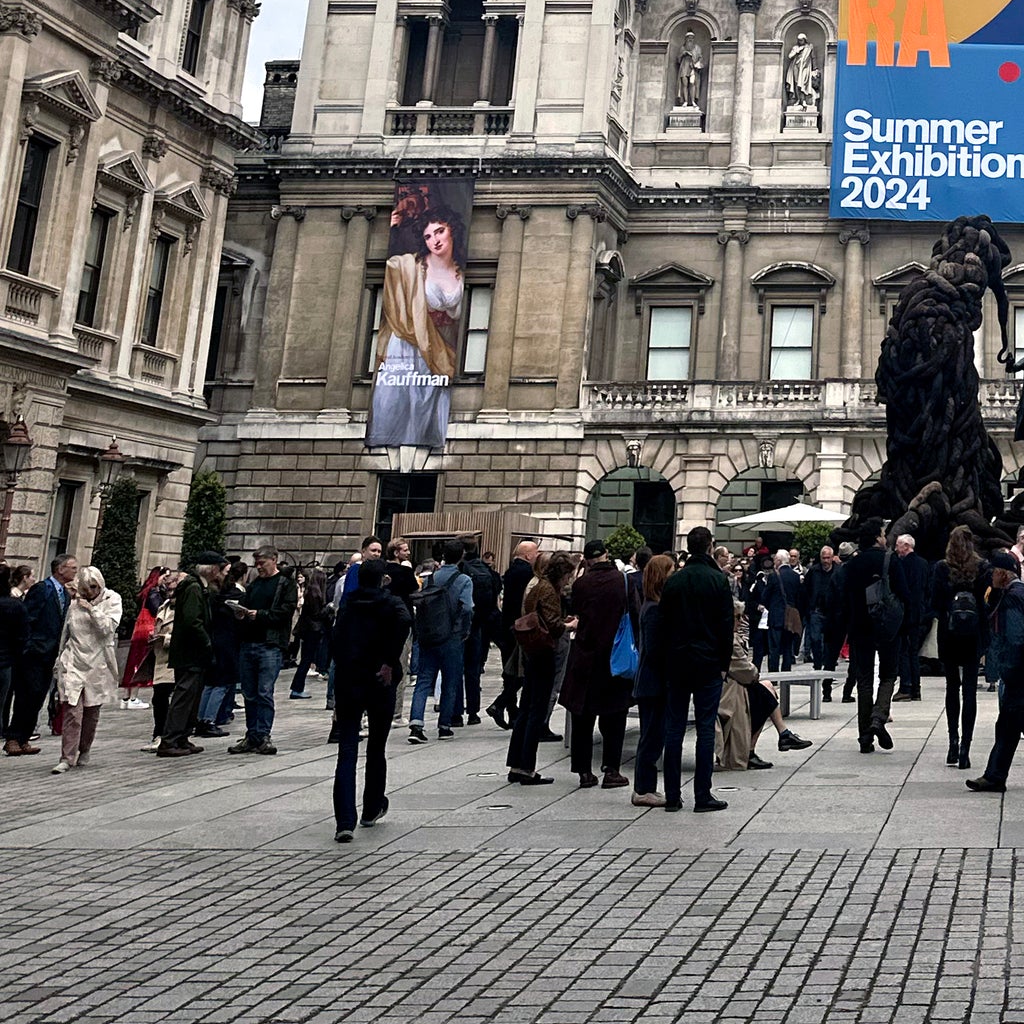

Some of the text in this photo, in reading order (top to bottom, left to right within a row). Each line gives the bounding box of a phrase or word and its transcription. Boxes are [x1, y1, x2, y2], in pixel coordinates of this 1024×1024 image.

[843, 108, 1004, 145] Summer
[840, 175, 931, 211] 2024
[376, 372, 449, 386] Kauffman
[378, 362, 415, 371] Angelica
